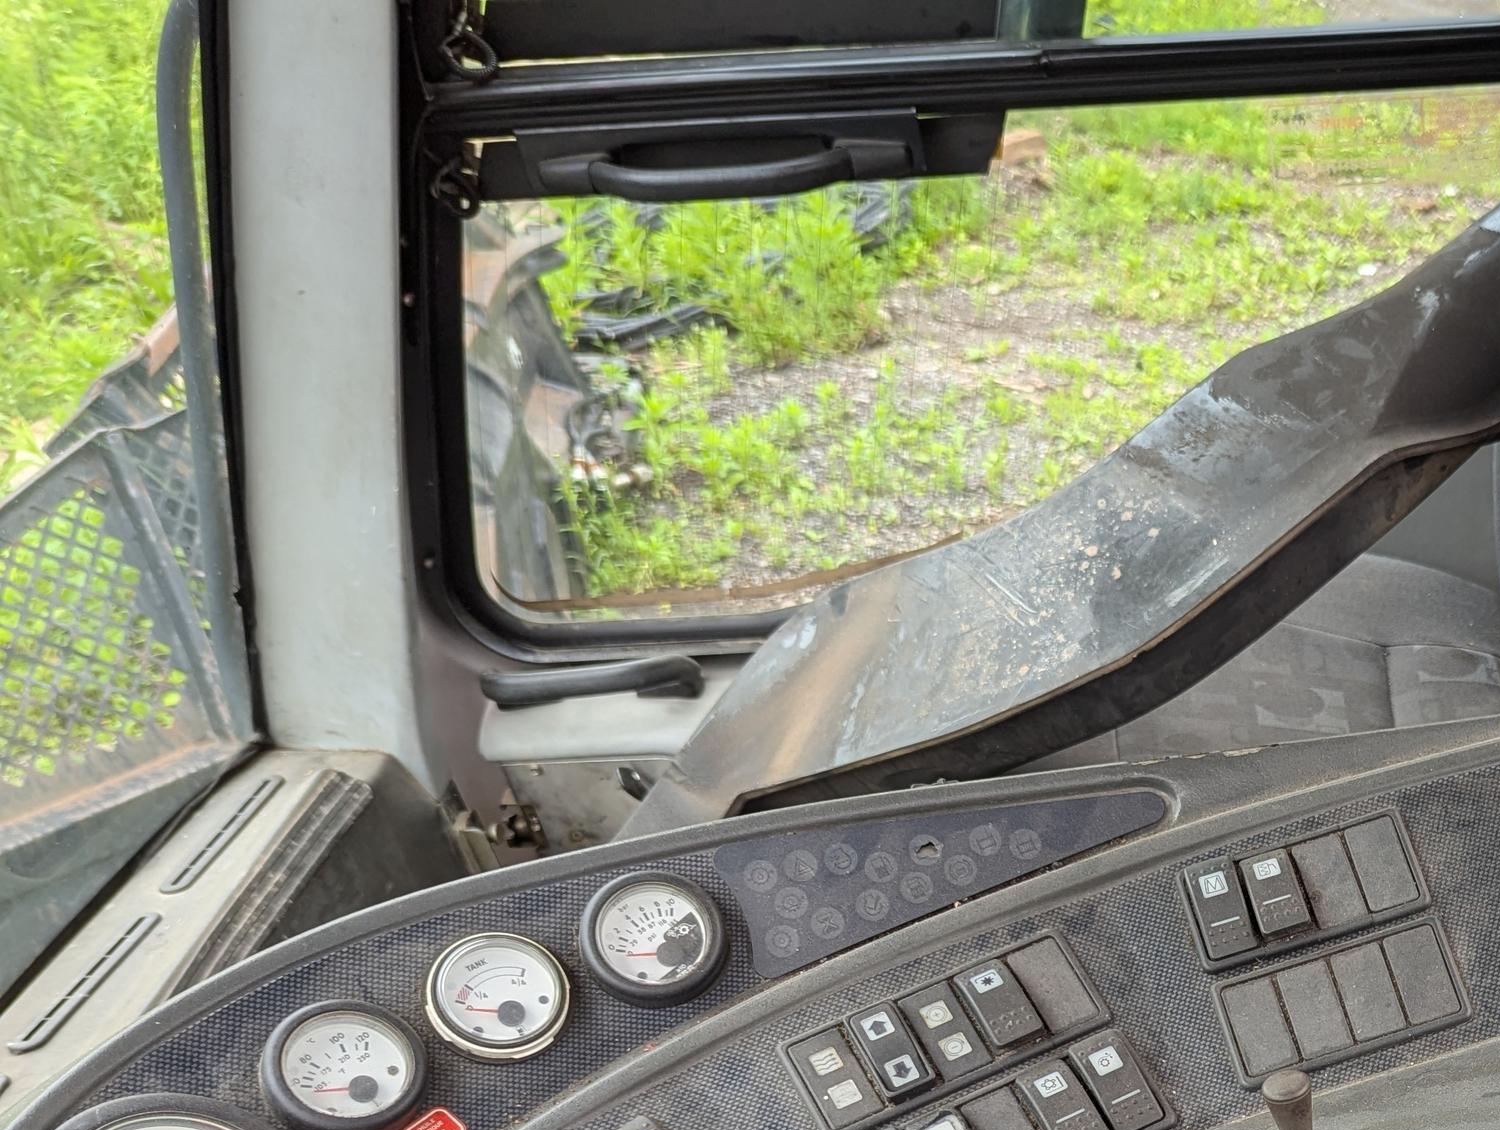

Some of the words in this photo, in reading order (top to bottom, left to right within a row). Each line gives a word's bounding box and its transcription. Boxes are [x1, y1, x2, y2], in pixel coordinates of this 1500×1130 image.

[465, 958, 489, 972] TANK
[511, 978, 527, 987] 4/4
[474, 991, 489, 1000] 1/4
[329, 1031, 345, 1045] 100
[355, 1031, 370, 1043] 120
[299, 1054, 312, 1064] 80
